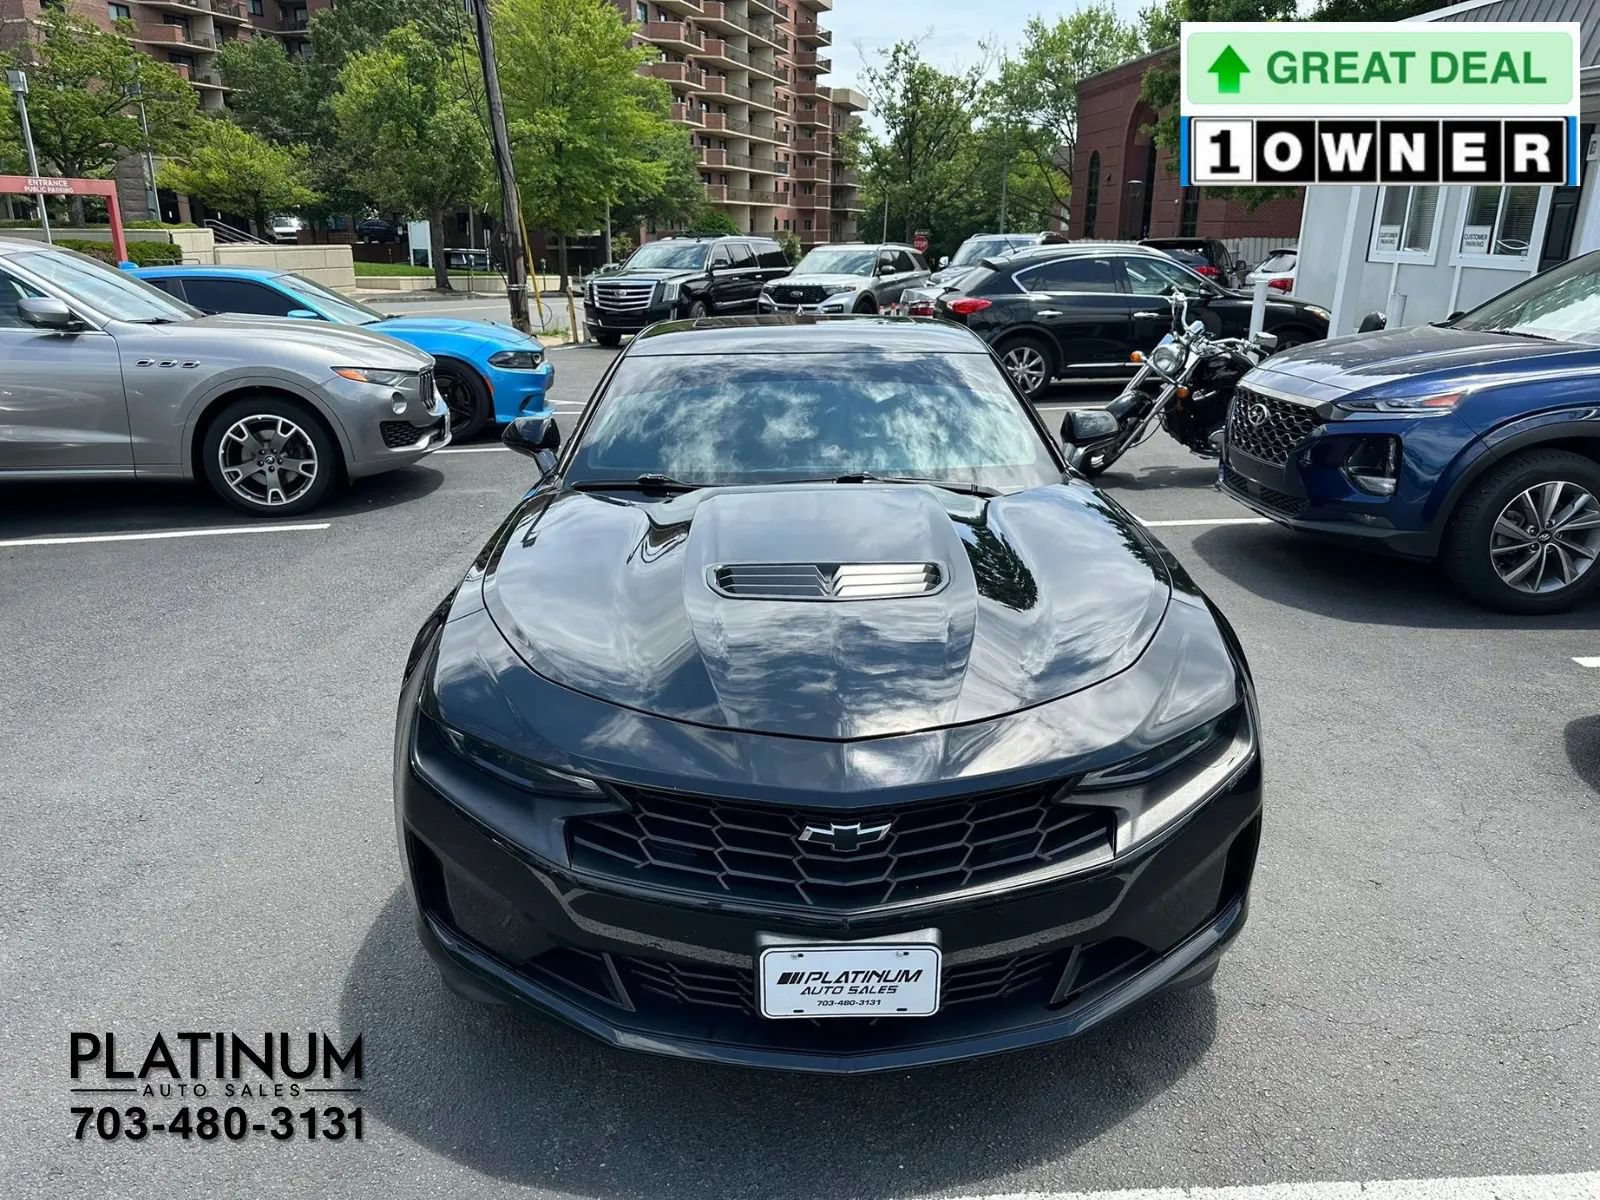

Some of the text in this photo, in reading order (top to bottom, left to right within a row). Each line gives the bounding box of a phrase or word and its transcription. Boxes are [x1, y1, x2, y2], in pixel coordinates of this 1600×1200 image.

[28, 179, 68, 187] ENTRANCE
[1463, 233, 1488, 241] CUSTOMER
[804, 969, 923, 985] PLATINUM
[800, 985, 899, 995] AUTO SALES
[816, 999, 881, 1007] 703-480-3131
